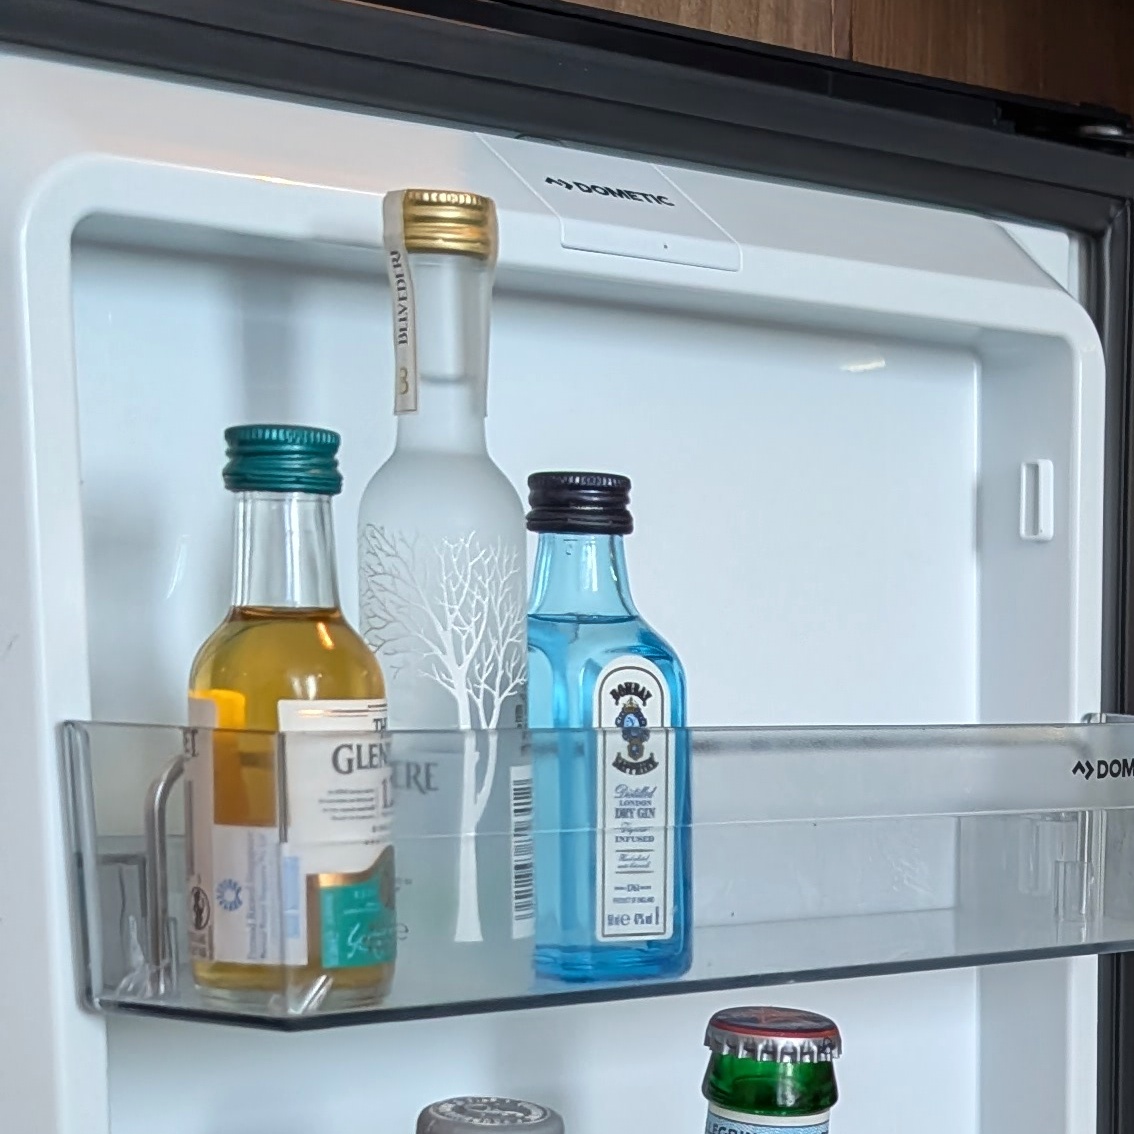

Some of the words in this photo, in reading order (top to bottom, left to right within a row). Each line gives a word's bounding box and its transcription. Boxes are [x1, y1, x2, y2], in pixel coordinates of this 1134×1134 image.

[575, 181, 675, 207] DOMETIC
[637, 808, 655, 819] GIN
[614, 835, 655, 843] INFUSED
